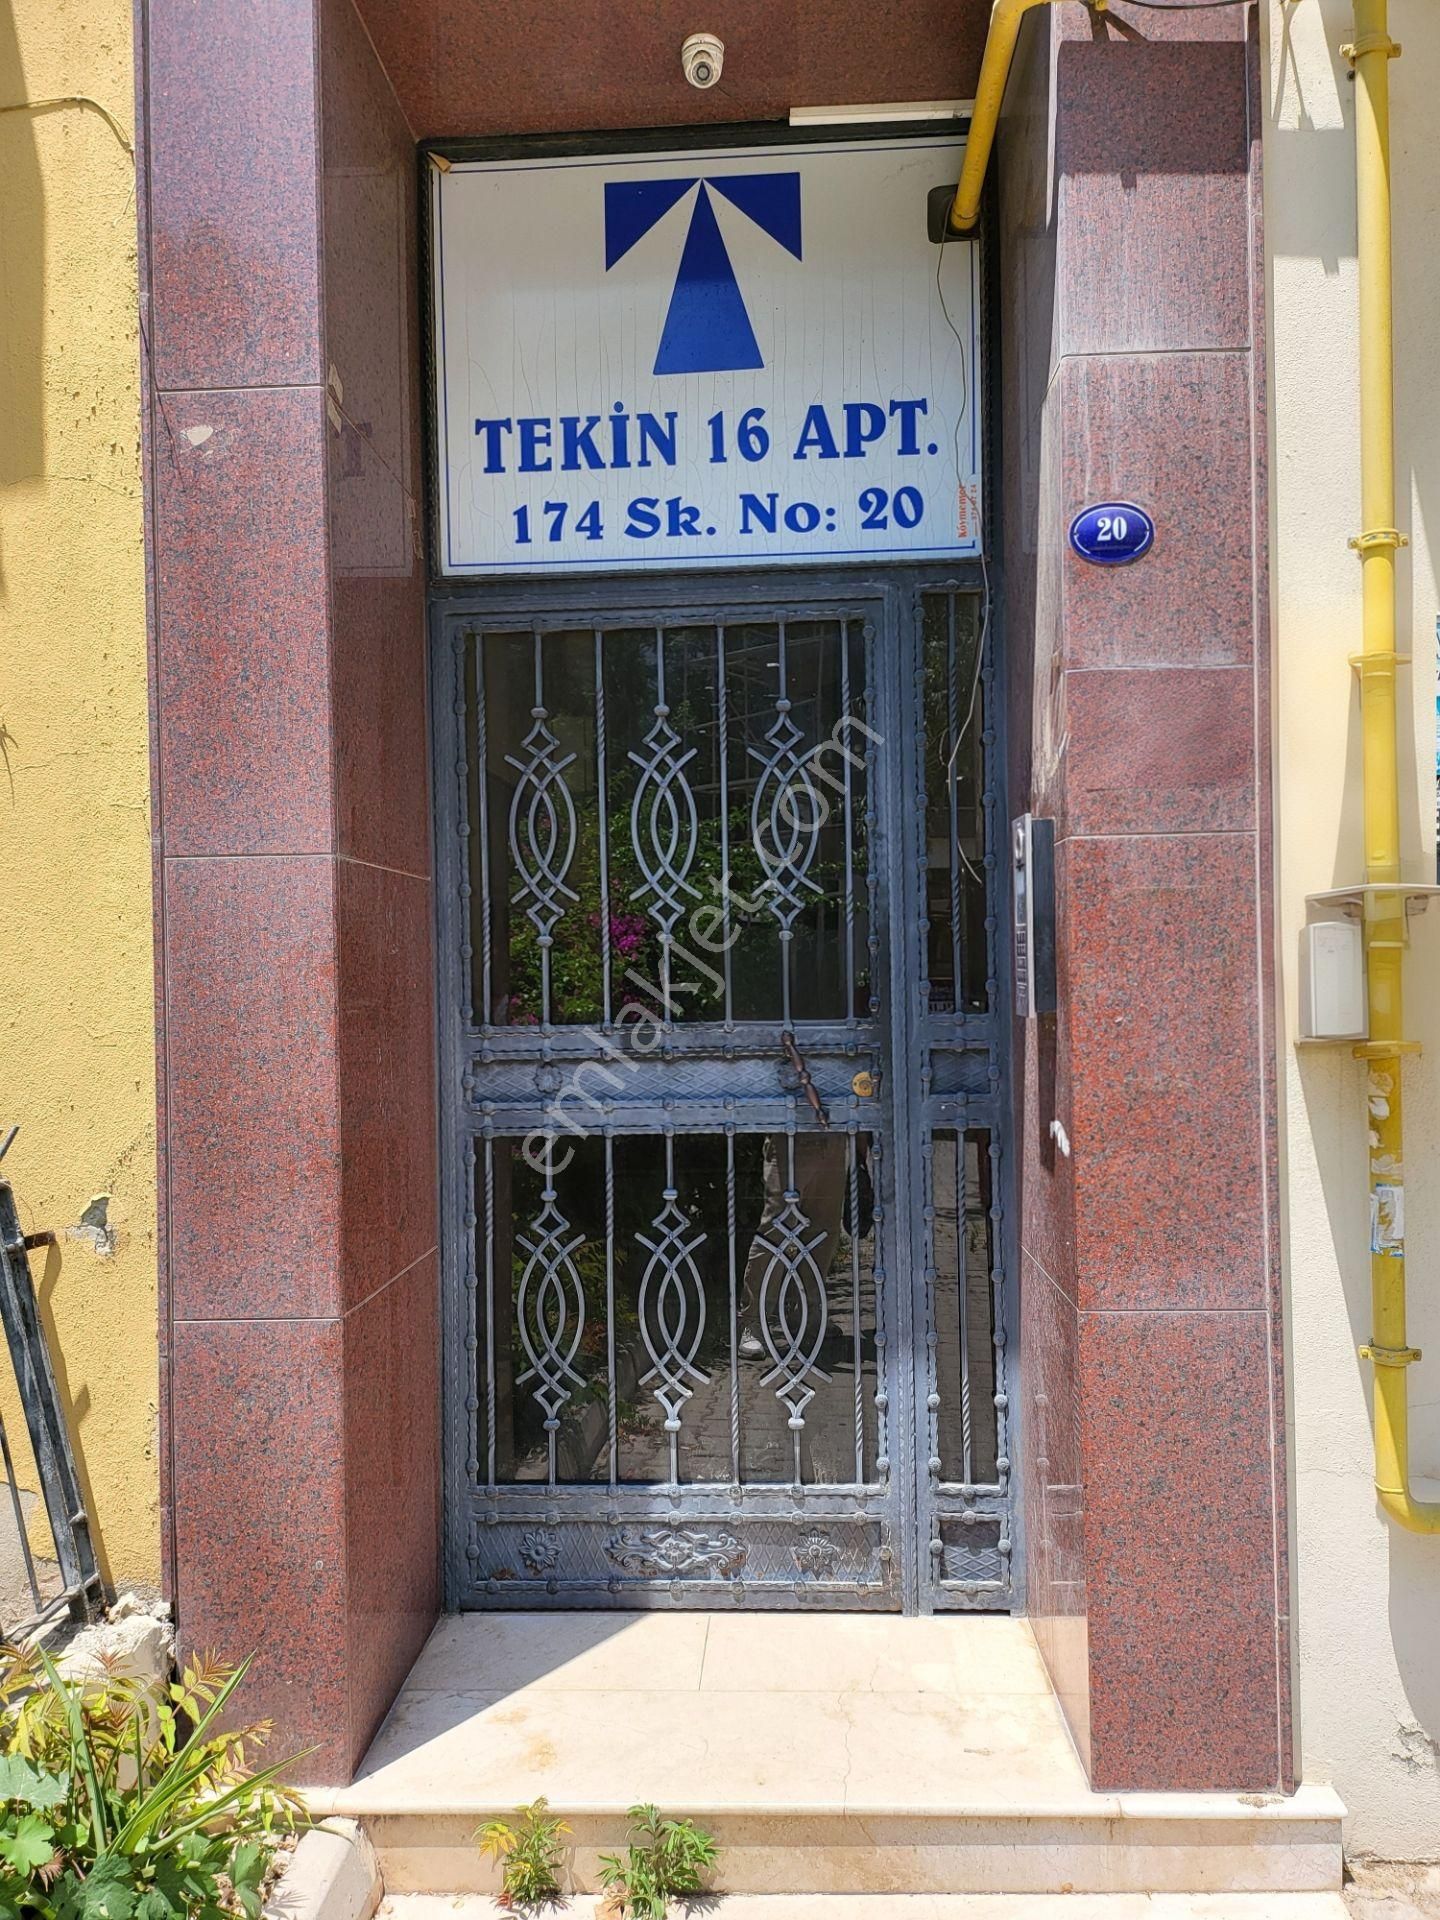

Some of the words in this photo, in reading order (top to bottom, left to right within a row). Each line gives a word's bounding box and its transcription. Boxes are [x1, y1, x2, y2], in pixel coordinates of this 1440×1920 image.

[474, 402, 678, 474] TEKİN
[708, 407, 770, 464] 16
[793, 399, 939, 461] APT.
[513, 500, 604, 544] 174
[624, 496, 718, 539] Sk.
[739, 492, 837, 535] No:
[857, 485, 925, 531] 20
[1096, 516, 1128, 541] 20
